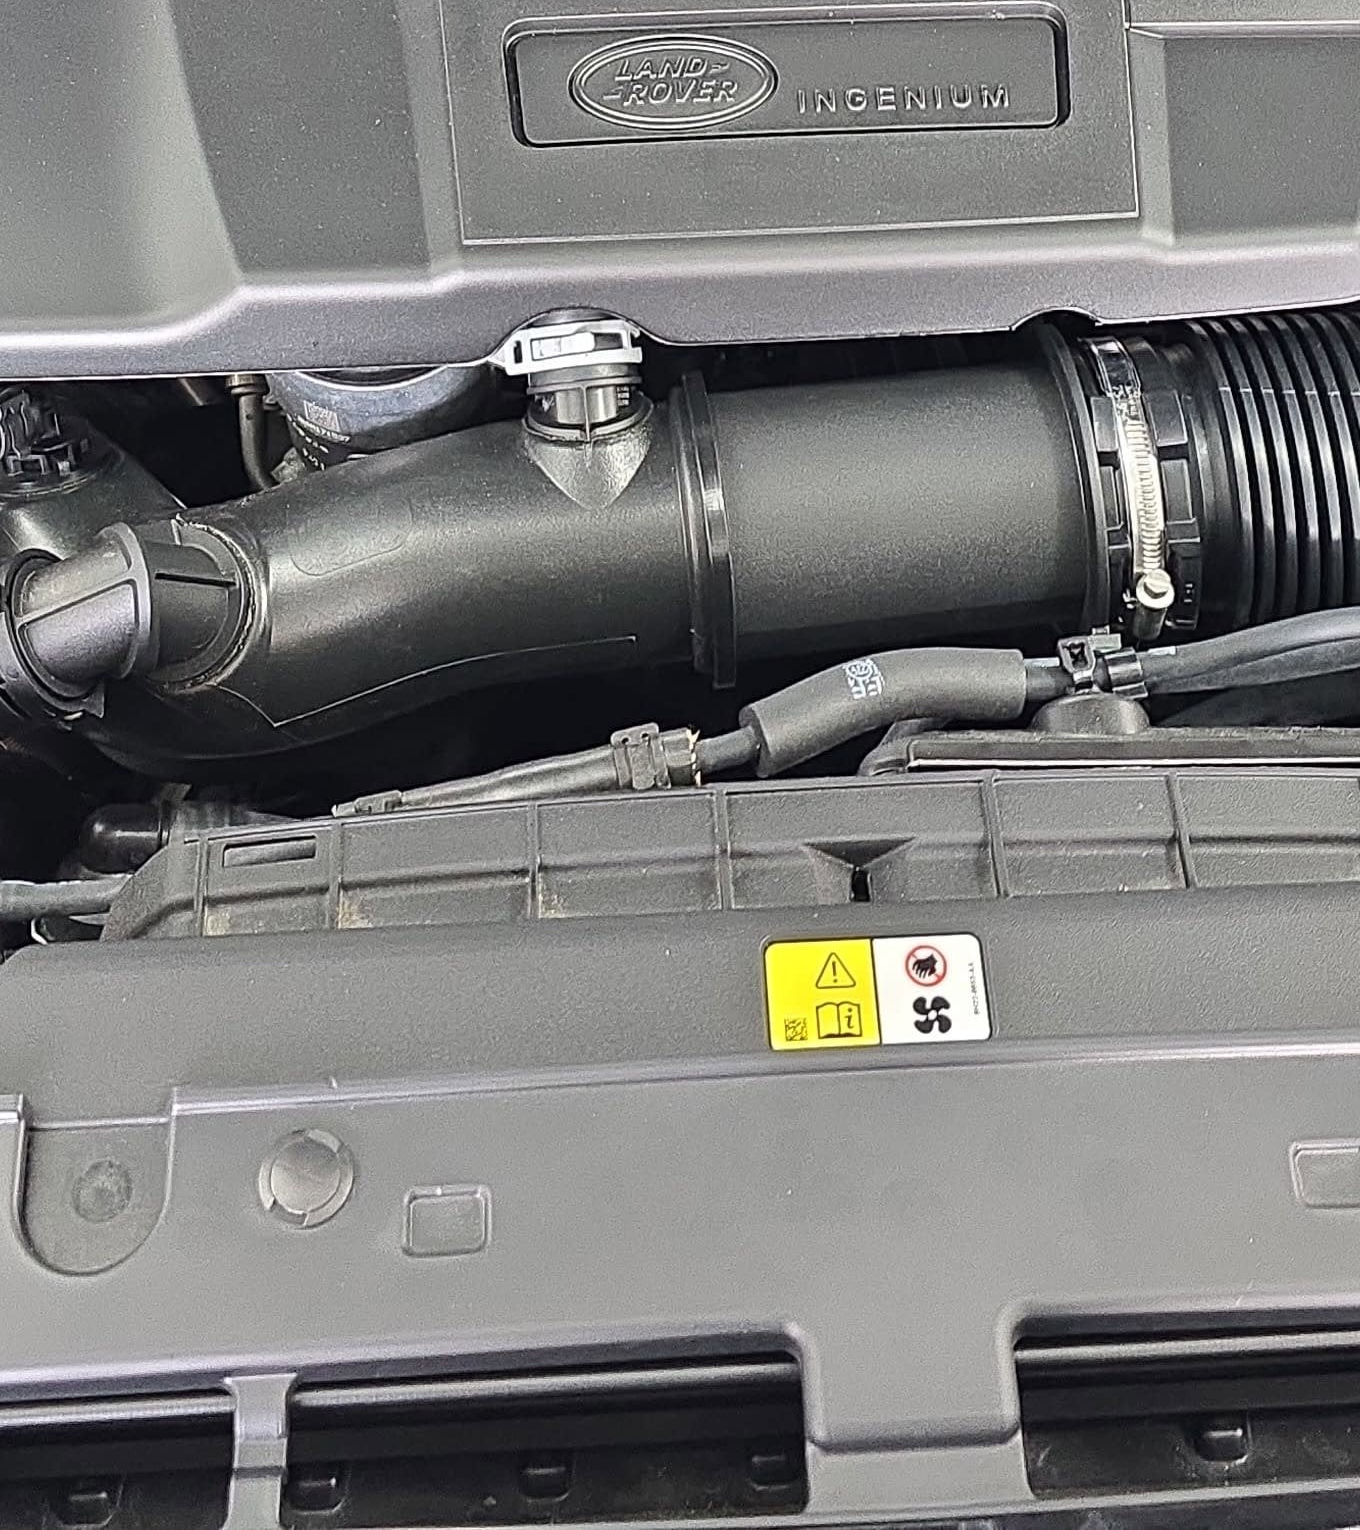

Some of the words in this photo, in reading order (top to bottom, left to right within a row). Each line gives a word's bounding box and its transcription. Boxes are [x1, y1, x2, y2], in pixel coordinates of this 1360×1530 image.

[614, 55, 709, 81] LAND
[623, 77, 738, 108] ROVER
[796, 83, 1011, 114] INGENIUM
